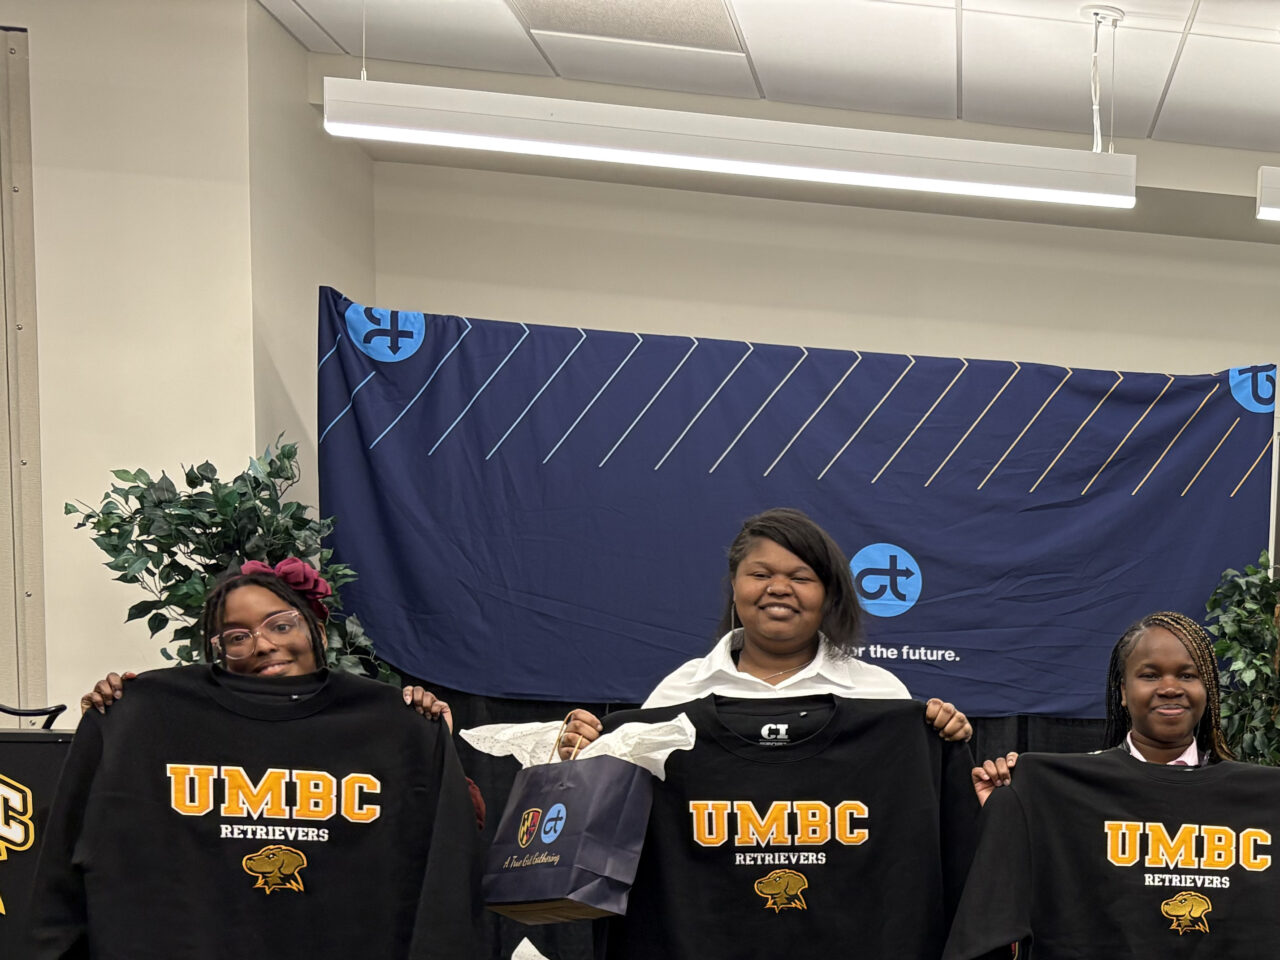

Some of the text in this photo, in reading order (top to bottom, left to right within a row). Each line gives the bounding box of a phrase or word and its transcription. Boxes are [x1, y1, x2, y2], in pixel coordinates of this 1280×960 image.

[869, 644, 898, 659] the
[901, 645, 961, 661] future.
[761, 723, 789, 740] CI
[166, 763, 382, 824] UMBC
[689, 800, 869, 848] UMBC
[220, 824, 329, 842] RETRIEVERS
[1104, 820, 1272, 872] UMBC
[735, 852, 827, 866] RETRIEVERS
[1144, 873, 1230, 889] RETRIEVERS
